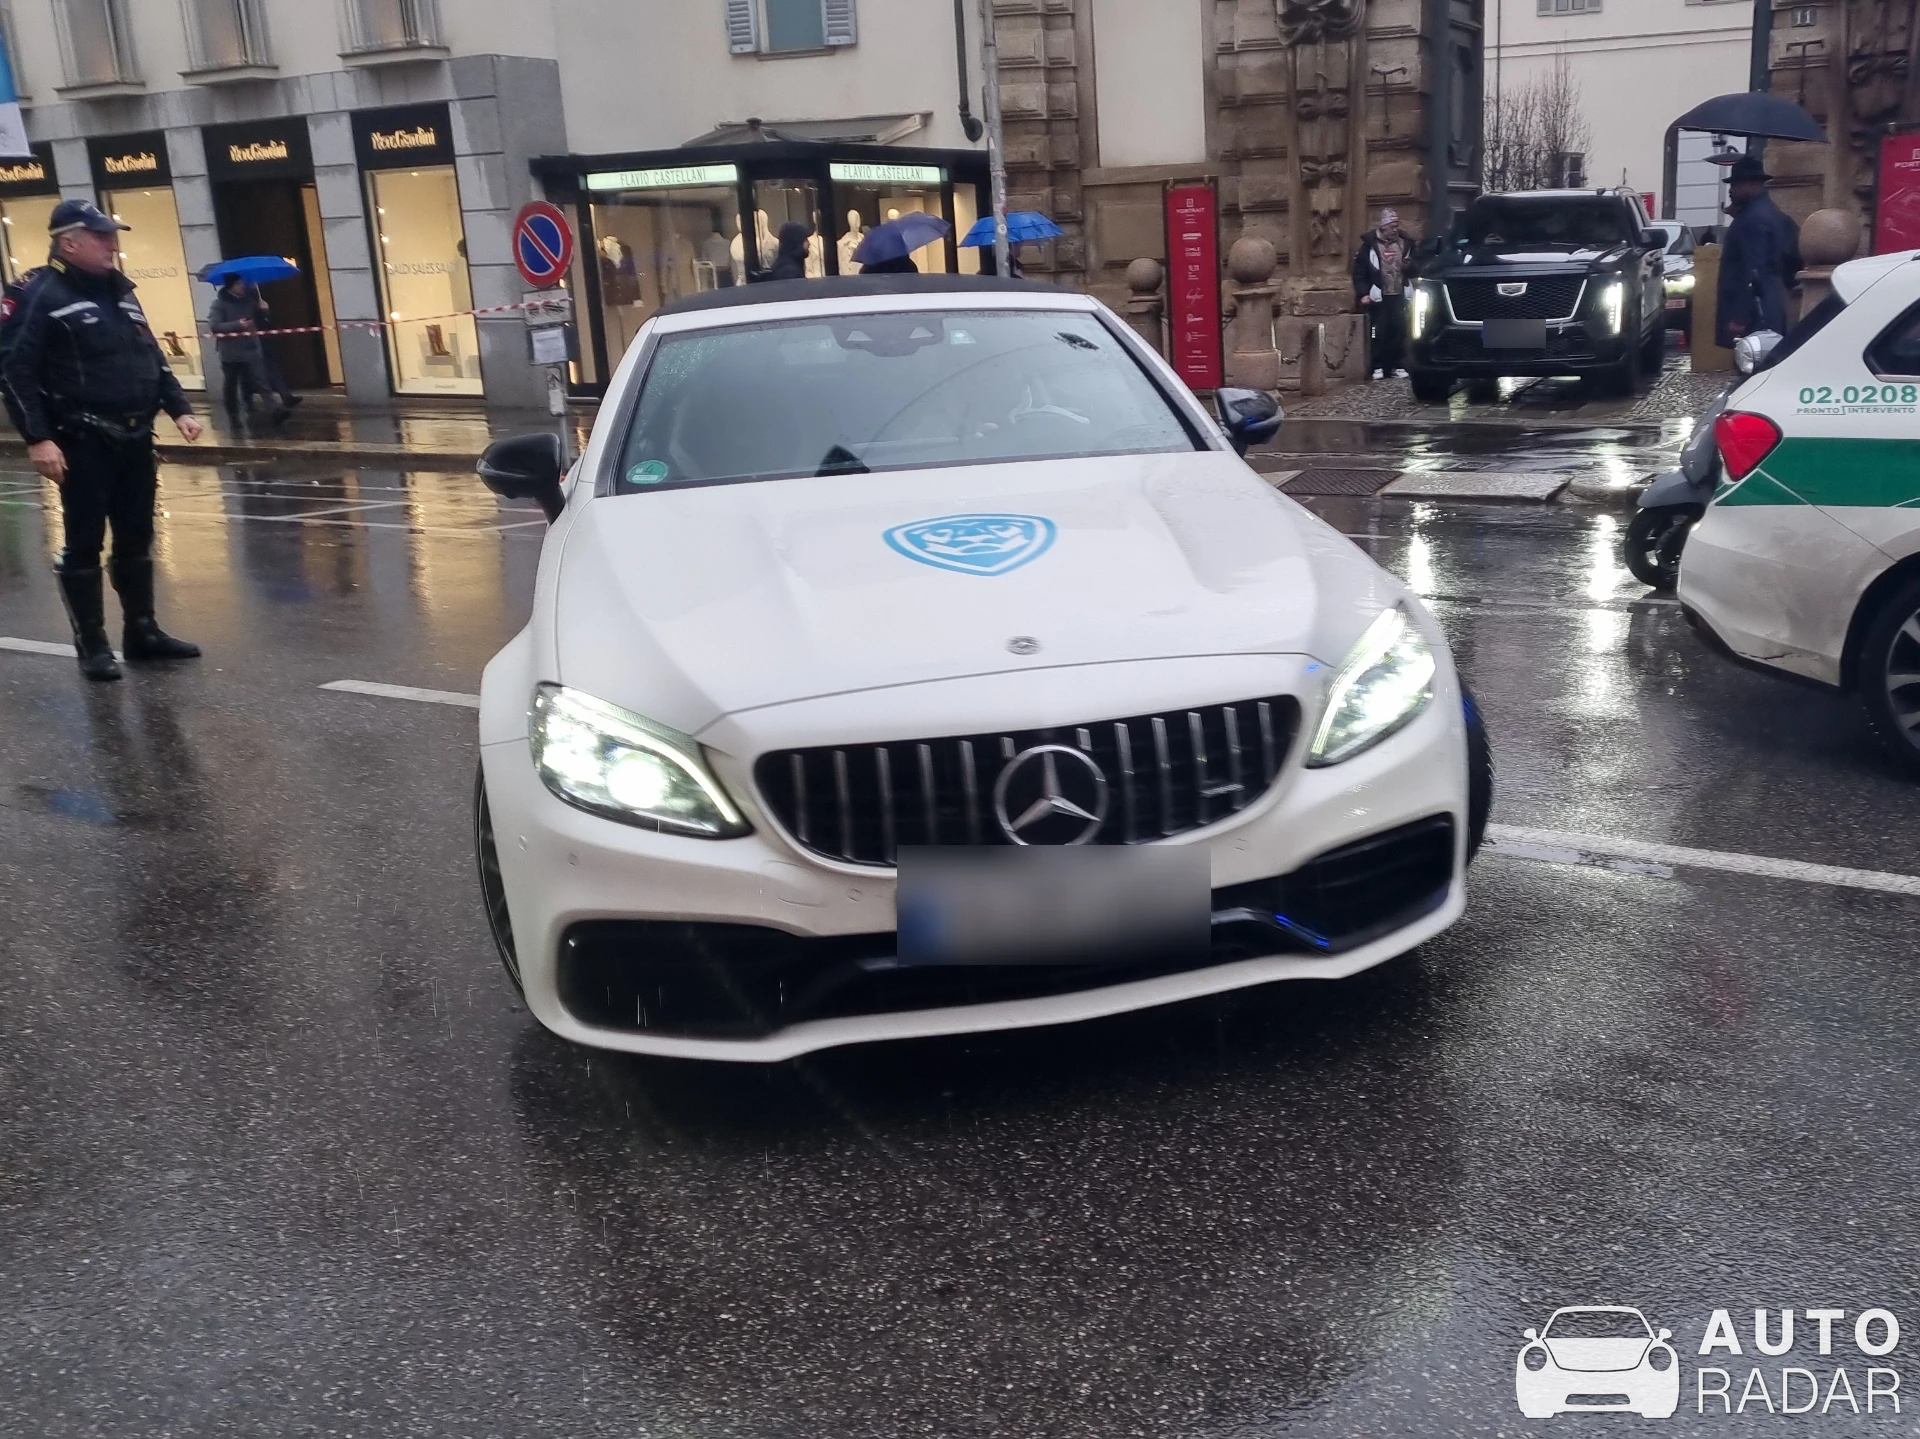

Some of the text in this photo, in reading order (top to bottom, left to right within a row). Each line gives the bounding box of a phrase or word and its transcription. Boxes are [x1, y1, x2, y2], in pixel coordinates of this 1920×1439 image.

[1795, 10, 1811, 24] 11
[620, 168, 706, 186] FLAVIO CASTELLANI
[843, 165, 924, 180] FLAVIO CASTELLANI
[1799, 385, 1918, 404] 02.0208
